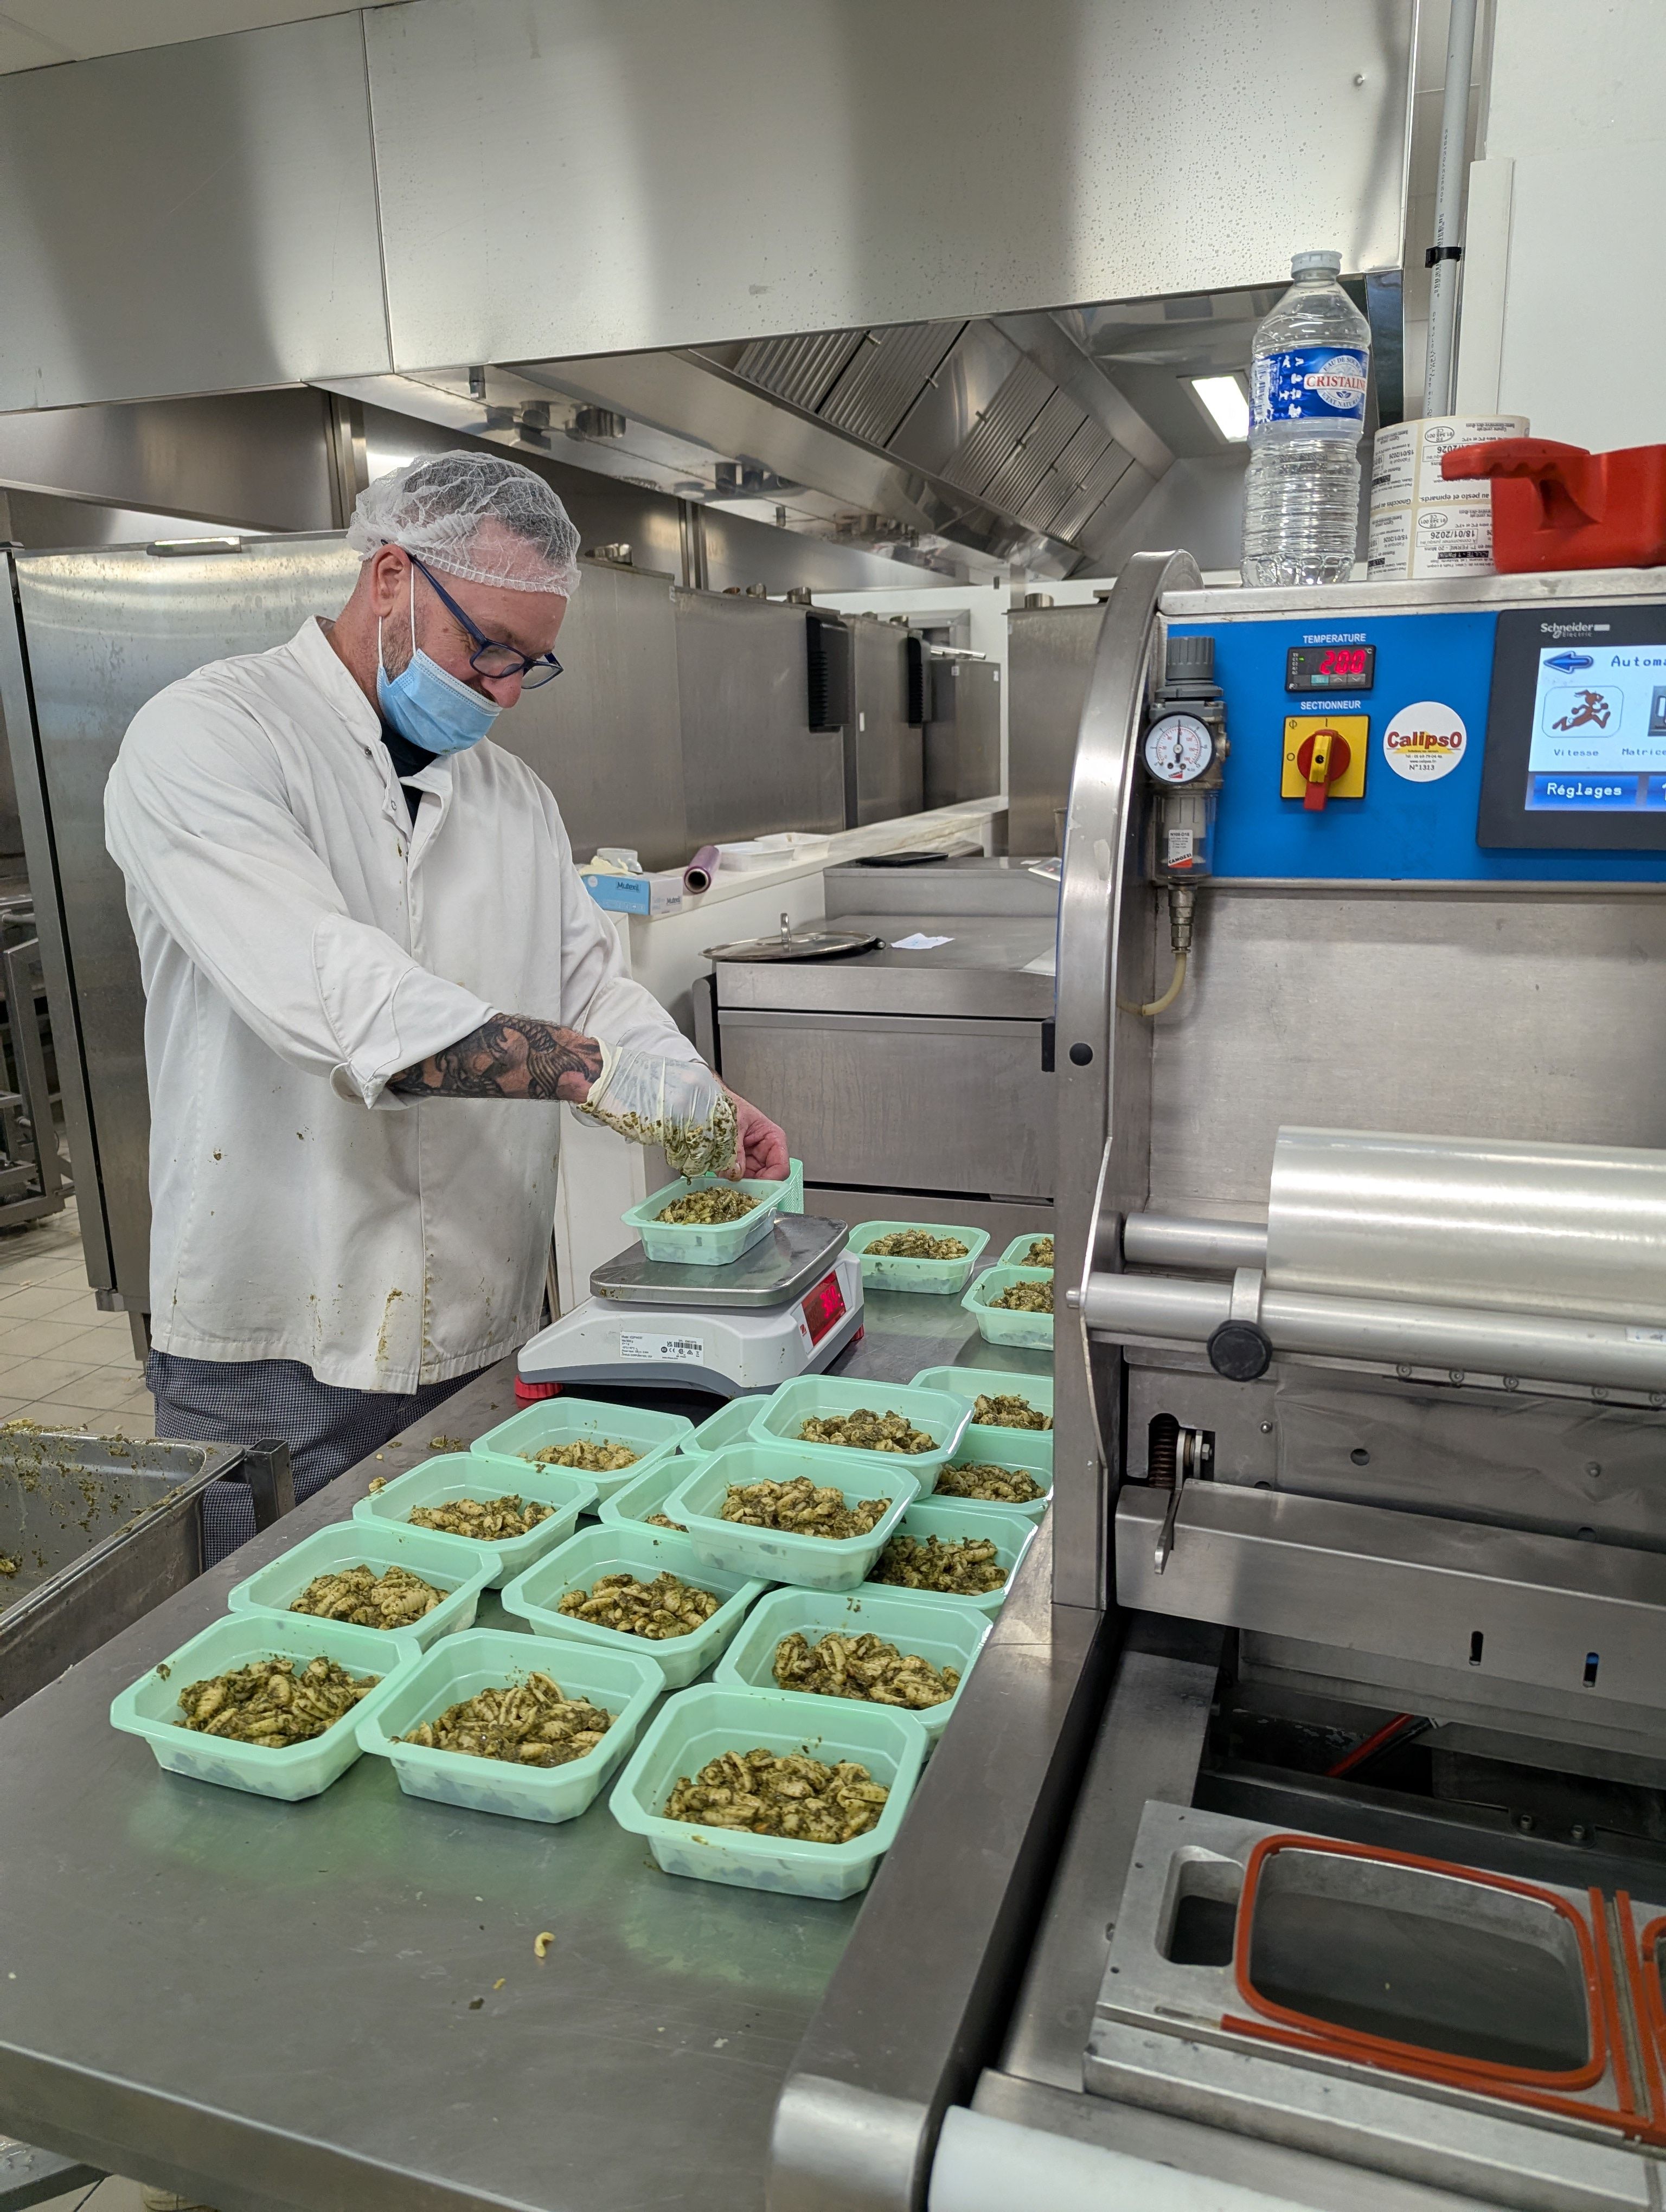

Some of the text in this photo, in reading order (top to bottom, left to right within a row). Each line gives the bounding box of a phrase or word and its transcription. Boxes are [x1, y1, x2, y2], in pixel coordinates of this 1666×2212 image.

[1387, 499, 1411, 508] Gnocchis
[1431, 530, 1475, 539] 18/01/2026
[1540, 622, 1594, 633] Schneider
[1303, 633, 1367, 644] TEMPERATURE
[1319, 650, 1367, 675] 200
[1300, 700, 1361, 710] SECTIONNEUR
[1554, 748, 1599, 757] Vitesse
[1547, 782, 1622, 799] Réglages
[616, 882, 640, 891] Mutexil
